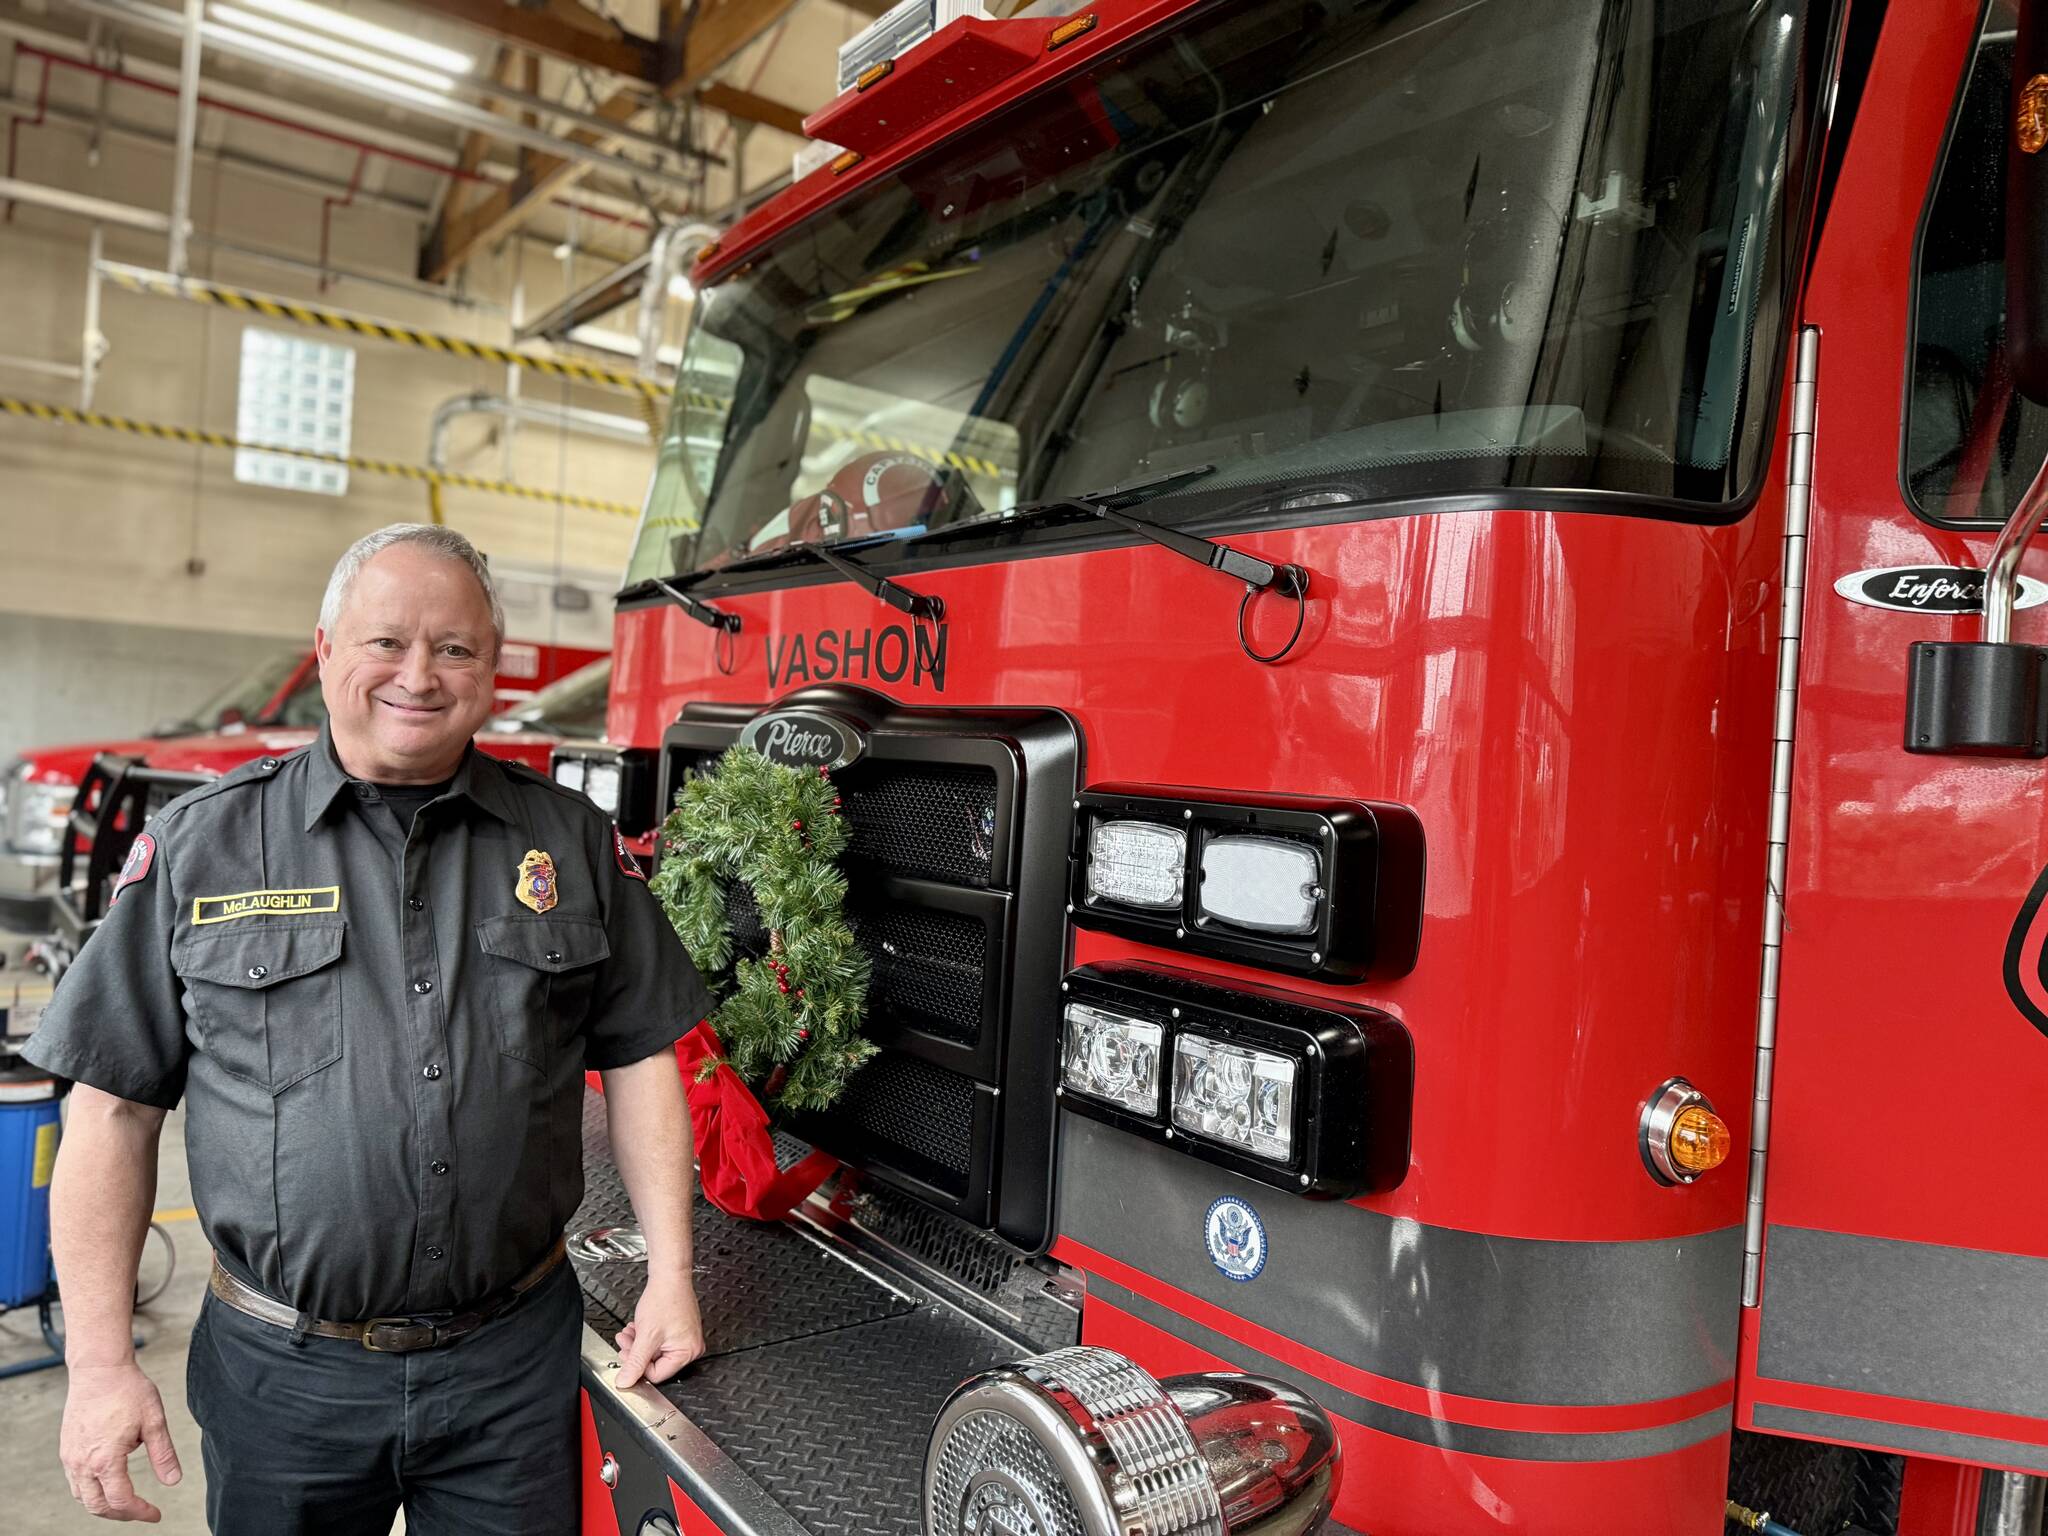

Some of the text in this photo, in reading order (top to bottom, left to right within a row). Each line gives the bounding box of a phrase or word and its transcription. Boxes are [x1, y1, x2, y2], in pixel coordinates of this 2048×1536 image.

[1888, 575, 1984, 606] Enforce
[765, 623, 948, 692] VASHON
[763, 719, 832, 759] Pierce
[223, 894, 312, 915] McLAUGHLIN
